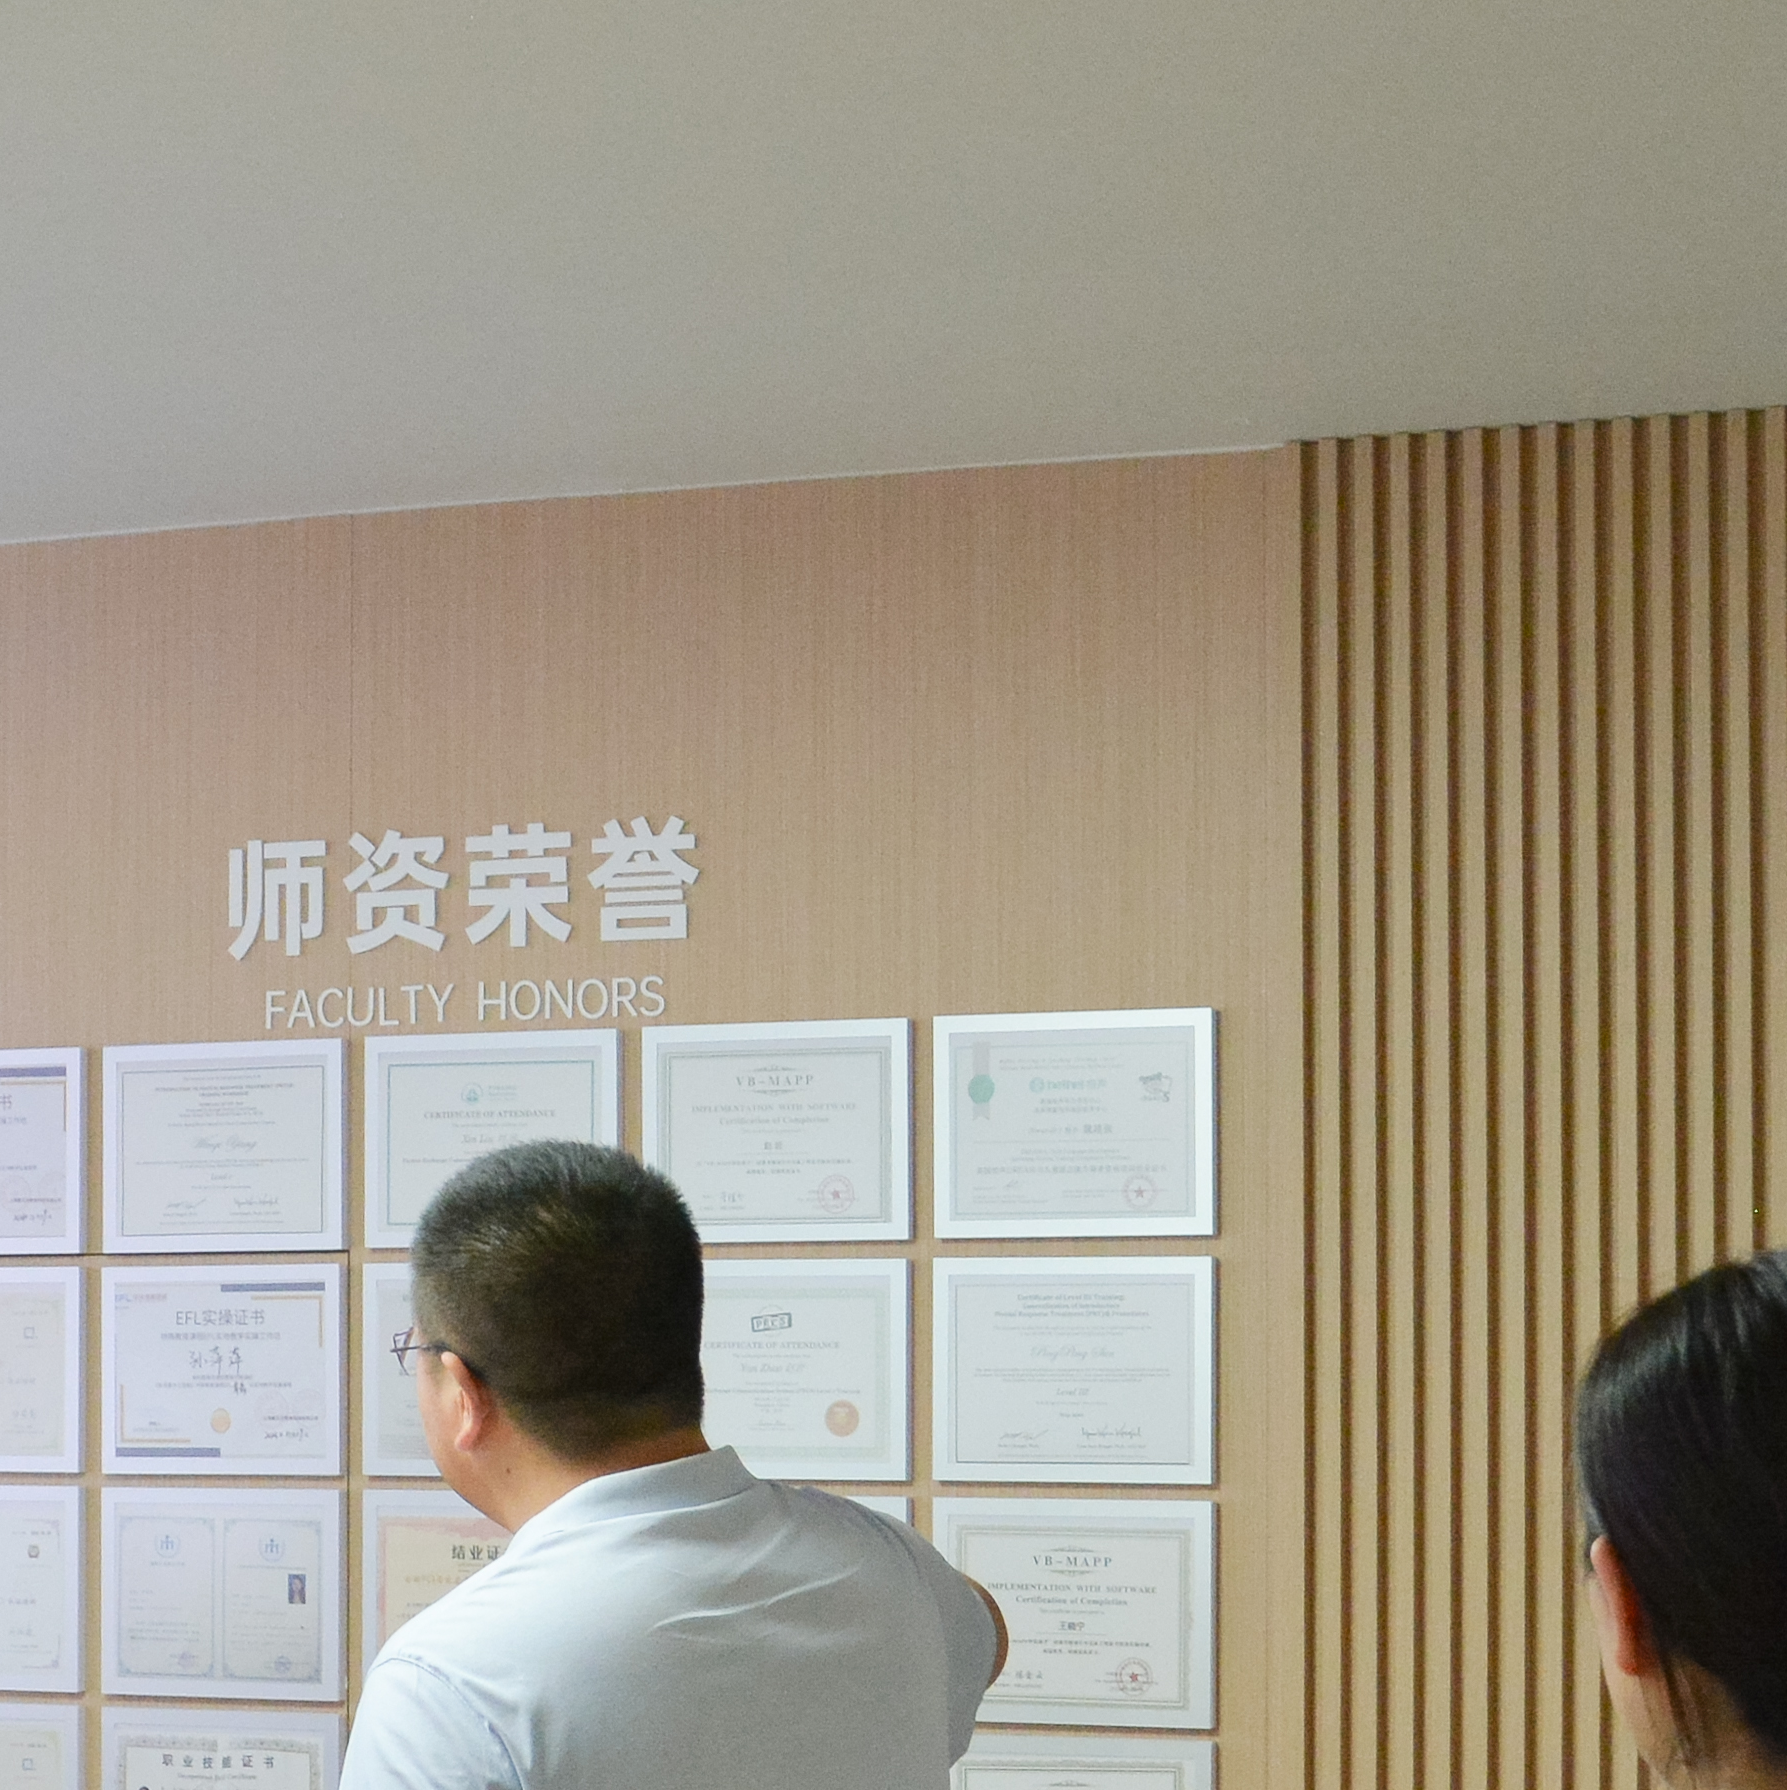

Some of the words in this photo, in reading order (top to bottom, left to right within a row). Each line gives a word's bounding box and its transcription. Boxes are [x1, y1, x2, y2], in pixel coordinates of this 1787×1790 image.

[226, 815, 701, 962] 师资荣誉
[264, 983, 455, 1030] FACULTY
[478, 974, 666, 1022] HONORS
[735, 1074, 814, 1087] VB-MAPP
[175, 1309, 266, 1326] EFL实操证书
[1032, 1554, 1113, 1569] VB-MAPP
[161, 1753, 276, 1770] 职业技能证书
